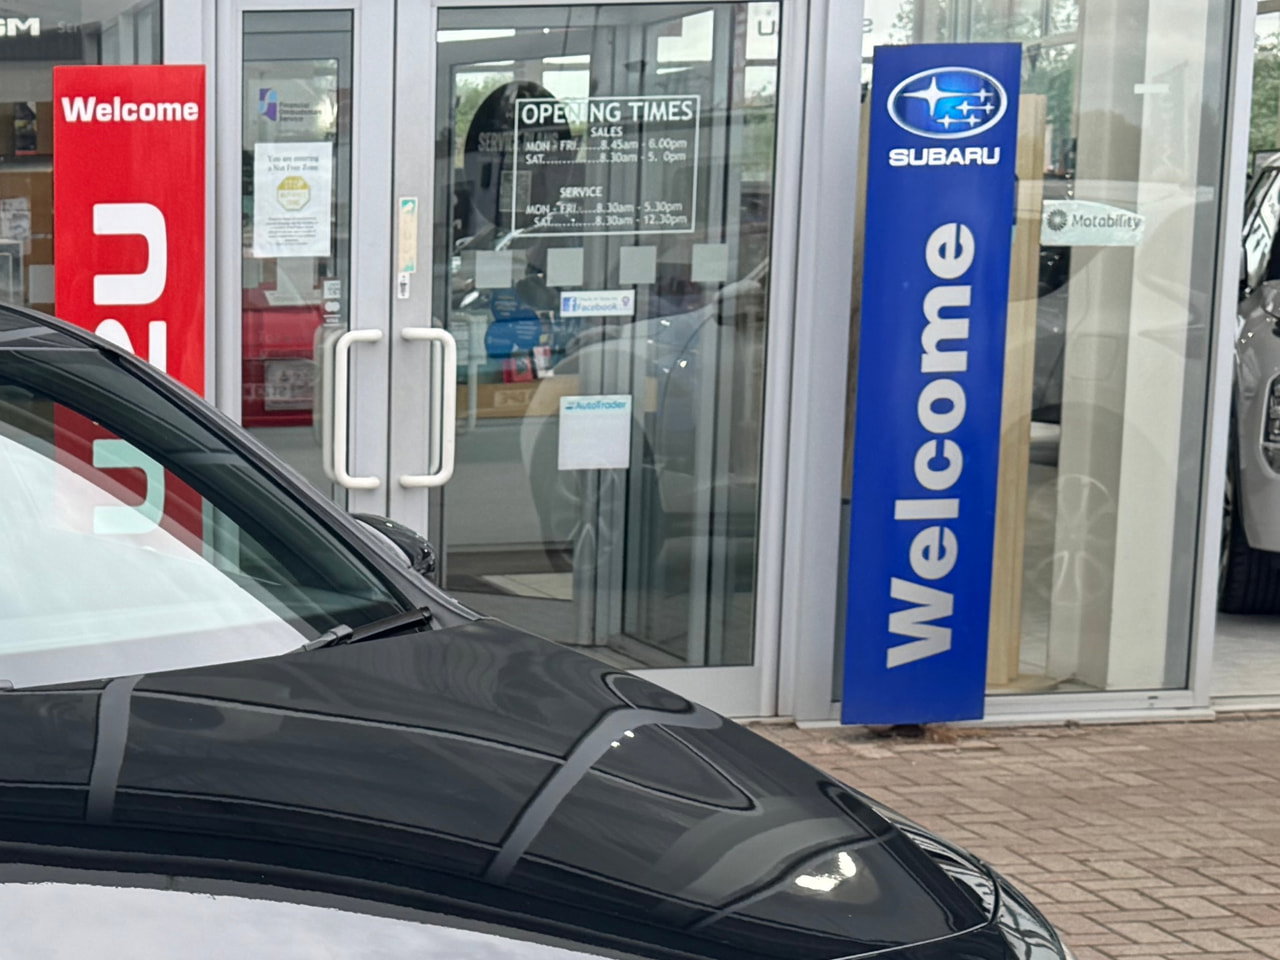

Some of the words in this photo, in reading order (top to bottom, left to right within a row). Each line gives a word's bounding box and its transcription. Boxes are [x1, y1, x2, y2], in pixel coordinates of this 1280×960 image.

[61, 96, 199, 123] Welcome
[628, 101, 693, 123] TIMES
[590, 126, 623, 138] SALES
[525, 141, 550, 152] MON
[888, 147, 1001, 167] SUBARU
[559, 186, 603, 198] SERVICE
[1071, 213, 1142, 231] Motability
[886, 222, 975, 669] Welcome
